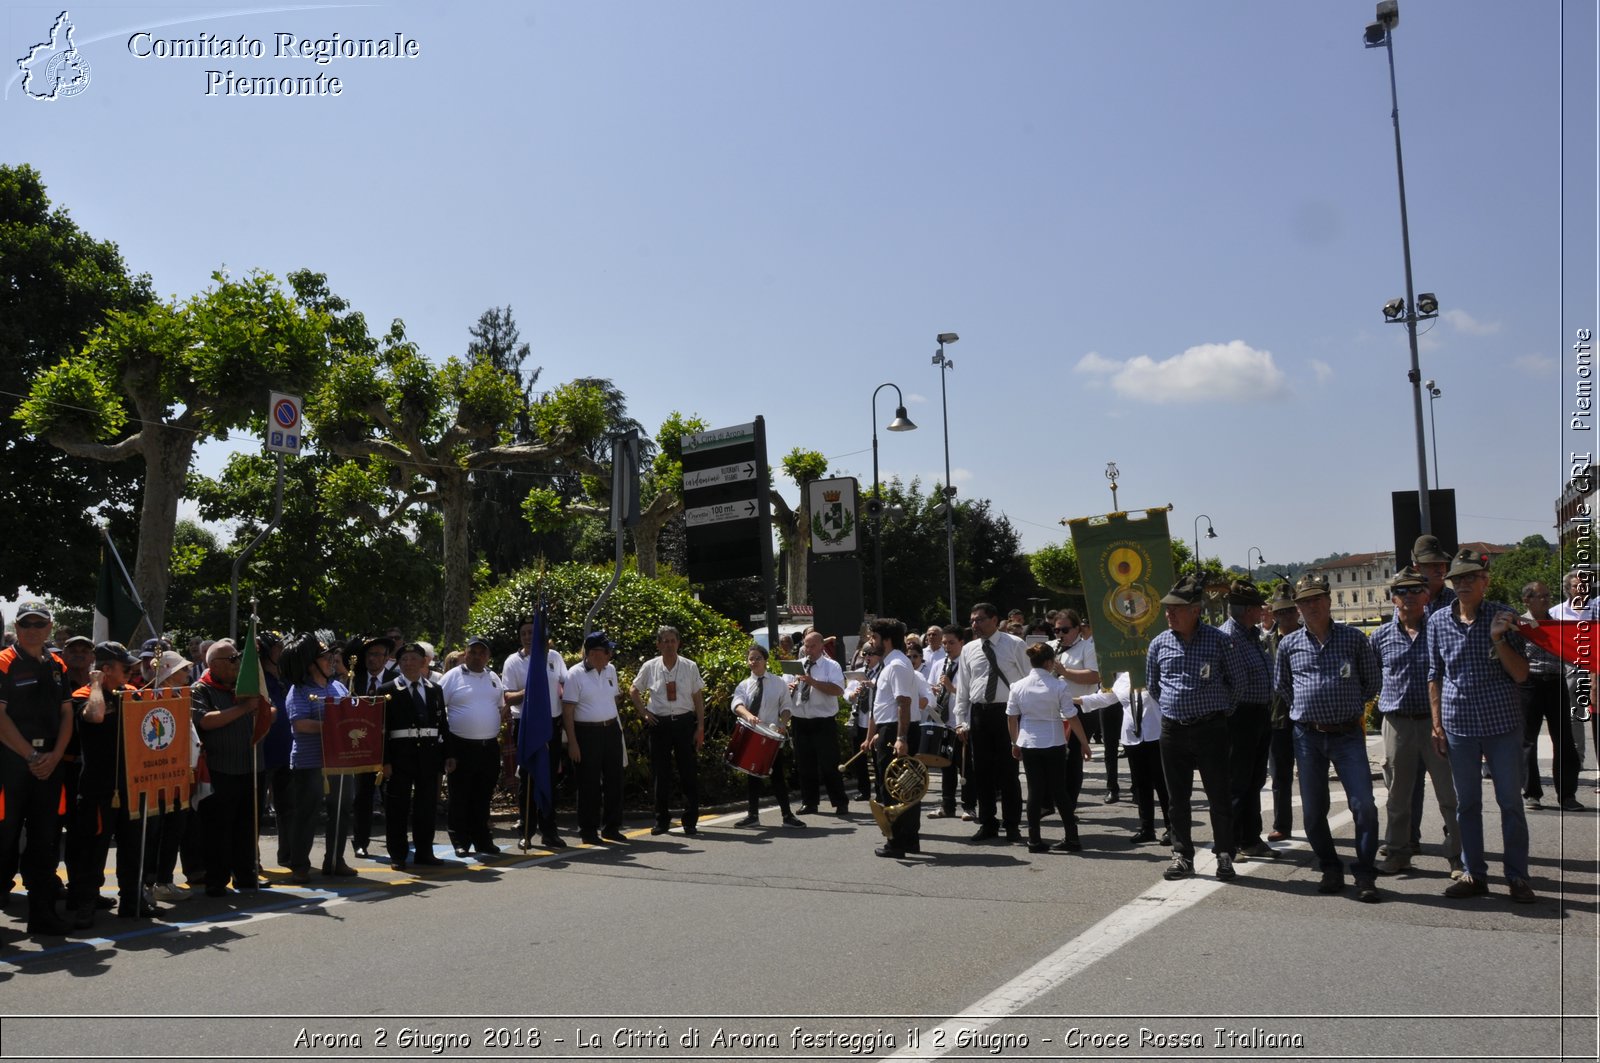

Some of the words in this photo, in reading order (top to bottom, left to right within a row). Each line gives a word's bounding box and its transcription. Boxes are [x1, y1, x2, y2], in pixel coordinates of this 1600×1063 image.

[726, 430, 745, 439] Arona
[711, 505, 723, 515] 100
[143, 758, 168, 768] SQUADRA
